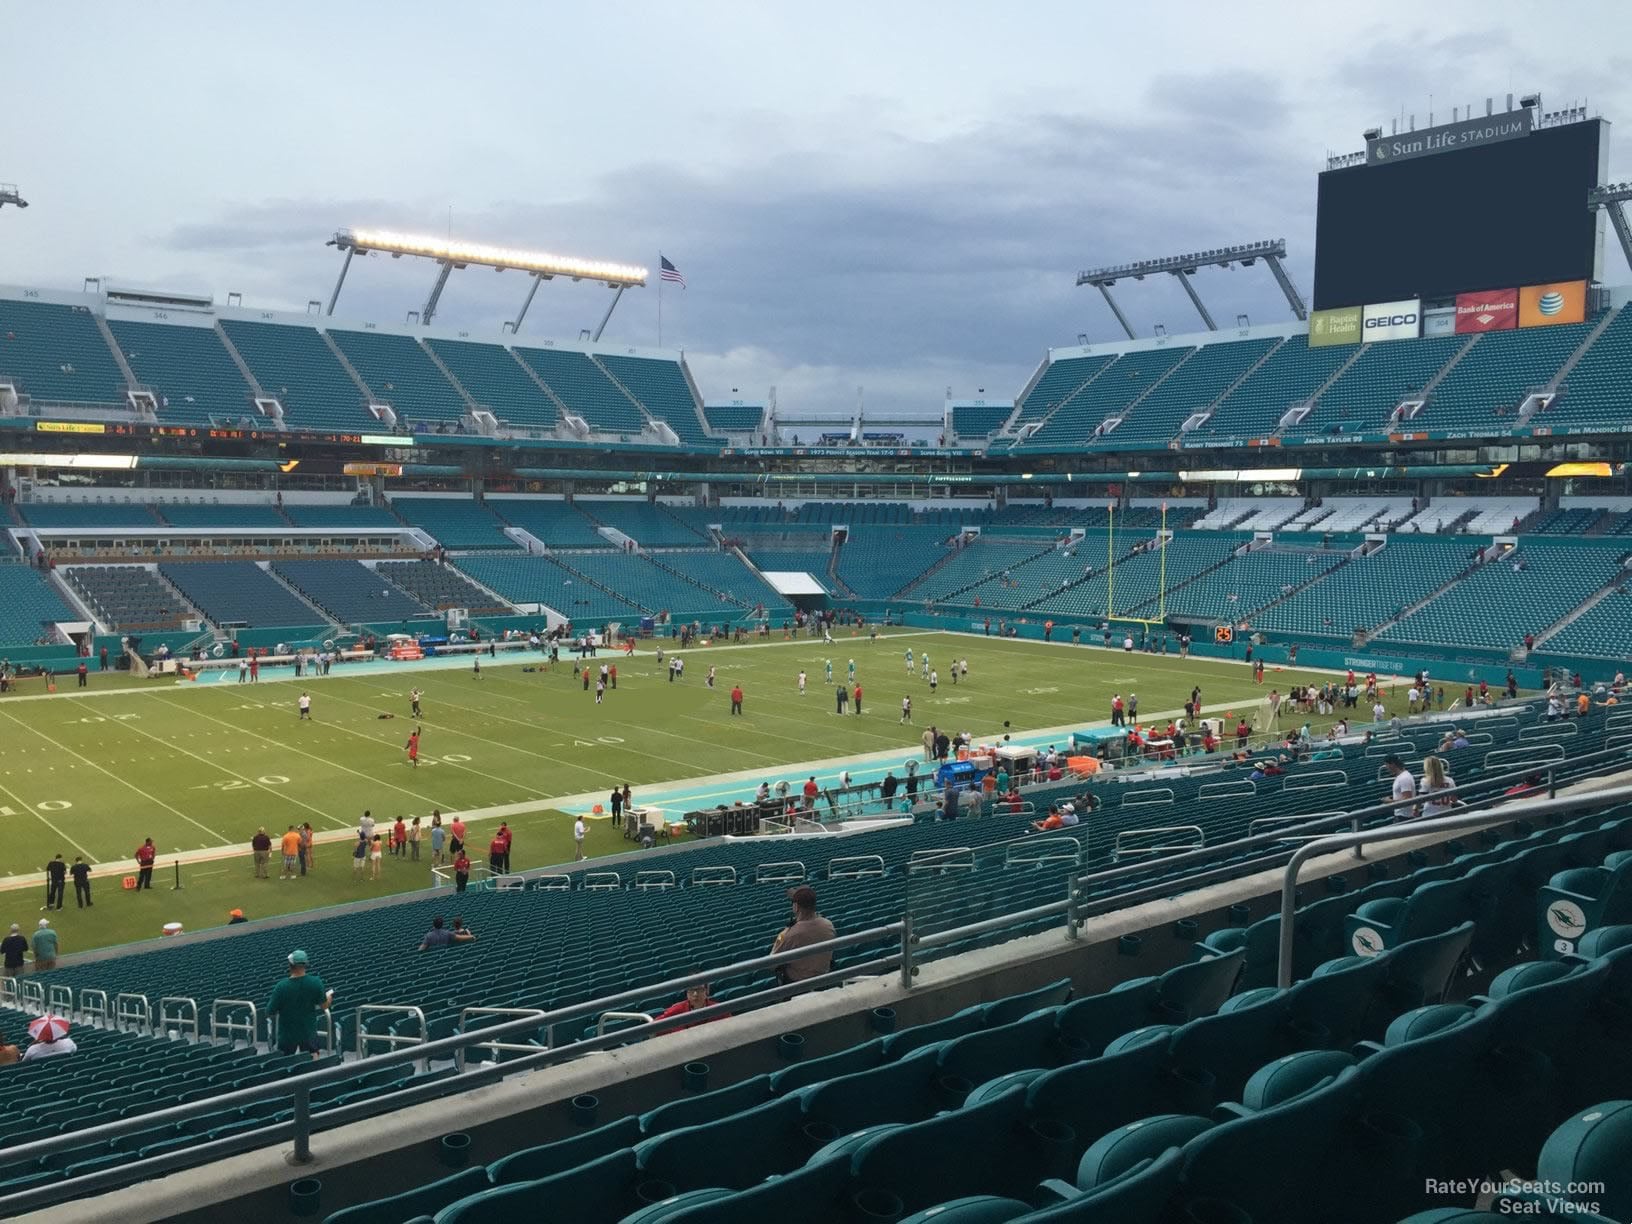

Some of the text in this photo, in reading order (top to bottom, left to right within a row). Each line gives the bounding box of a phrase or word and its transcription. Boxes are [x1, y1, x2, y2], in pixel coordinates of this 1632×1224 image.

[1392, 121, 1523, 156] Sun Life STADIUM
[1457, 305, 1476, 314] Bank
[1483, 302, 1514, 311] America
[1365, 313, 1417, 329] GEICO
[1329, 322, 1356, 334] Health
[1217, 628, 1230, 640] 25
[1560, 942, 1568, 952] 3
